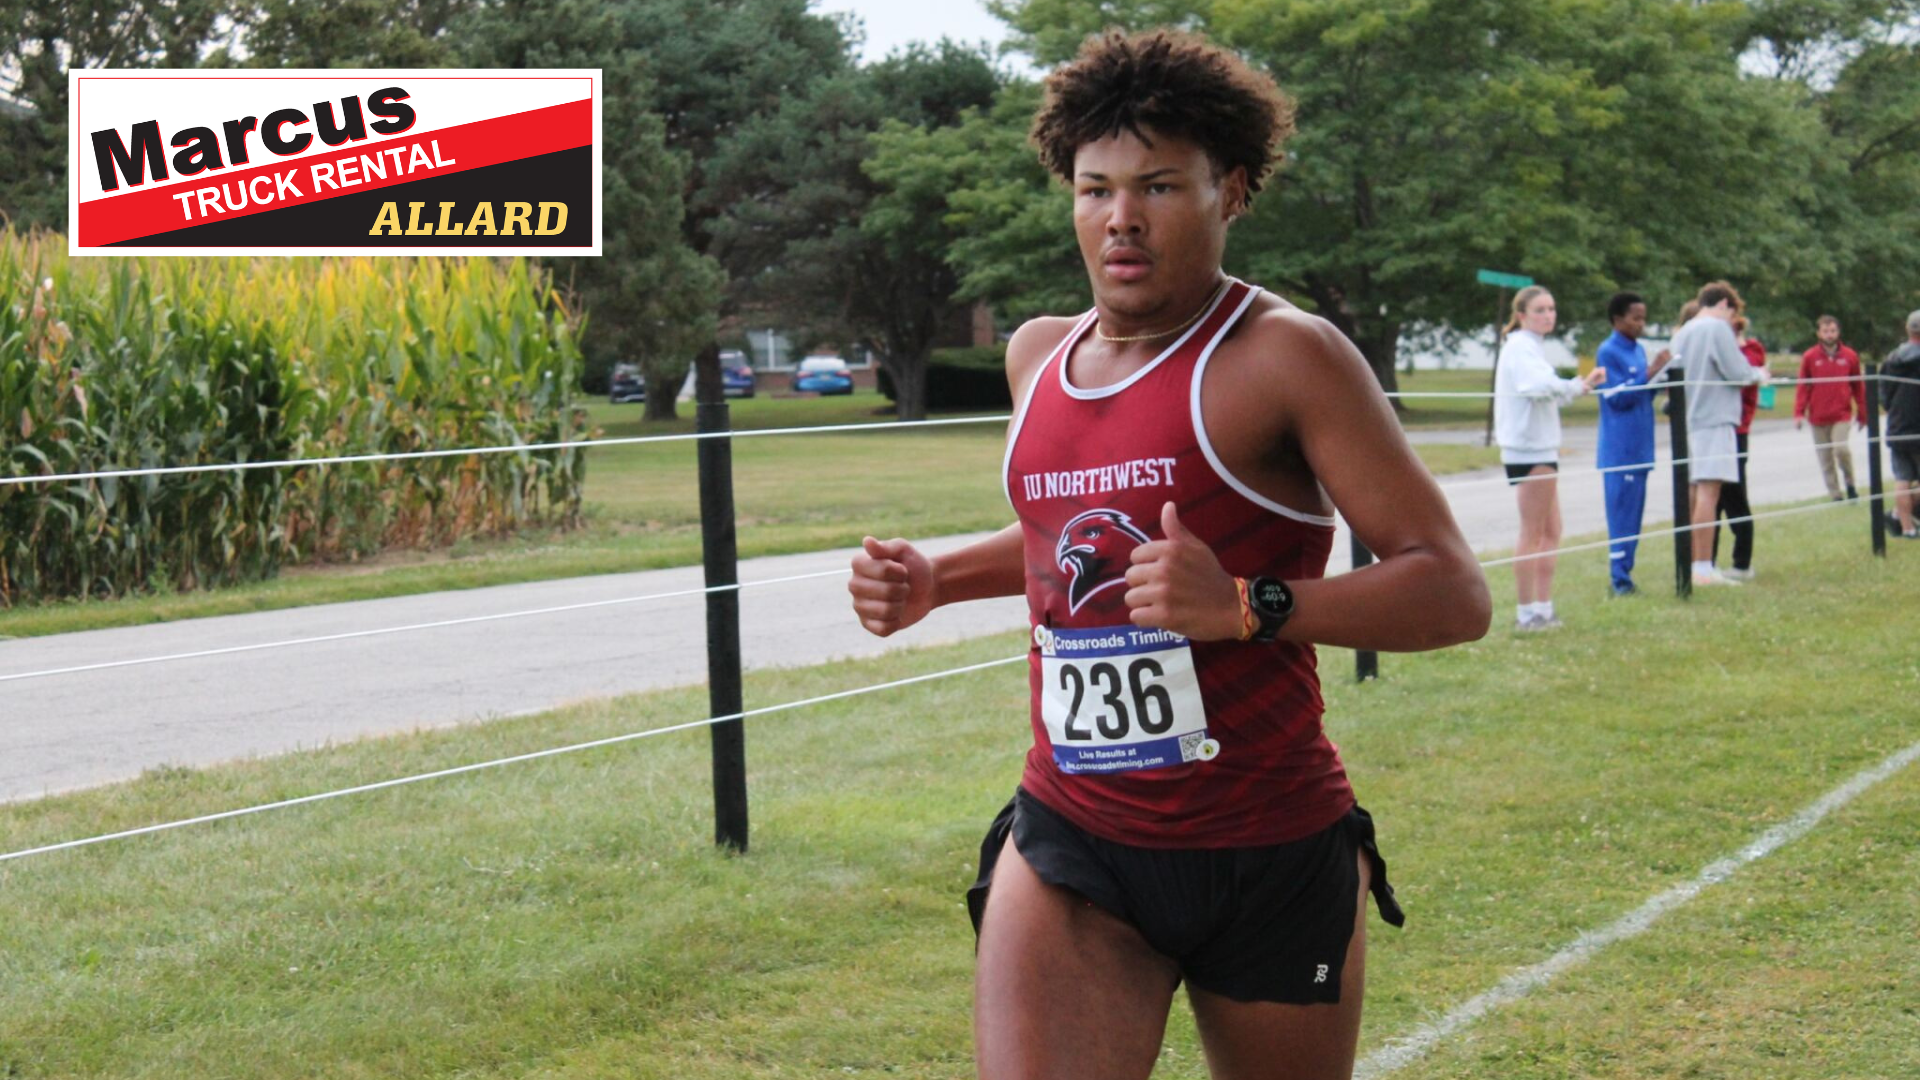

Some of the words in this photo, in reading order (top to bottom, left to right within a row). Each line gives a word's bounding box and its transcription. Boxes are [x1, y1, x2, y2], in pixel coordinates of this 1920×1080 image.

[1023, 474, 1042, 502] IU
[1044, 457, 1177, 499] NORTHWEST
[1054, 633, 1126, 650] Crossroads
[1059, 657, 1174, 741] 236
[1078, 750, 1094, 759] Live
[1095, 748, 1126, 759] Results
[1128, 748, 1137, 756] at
